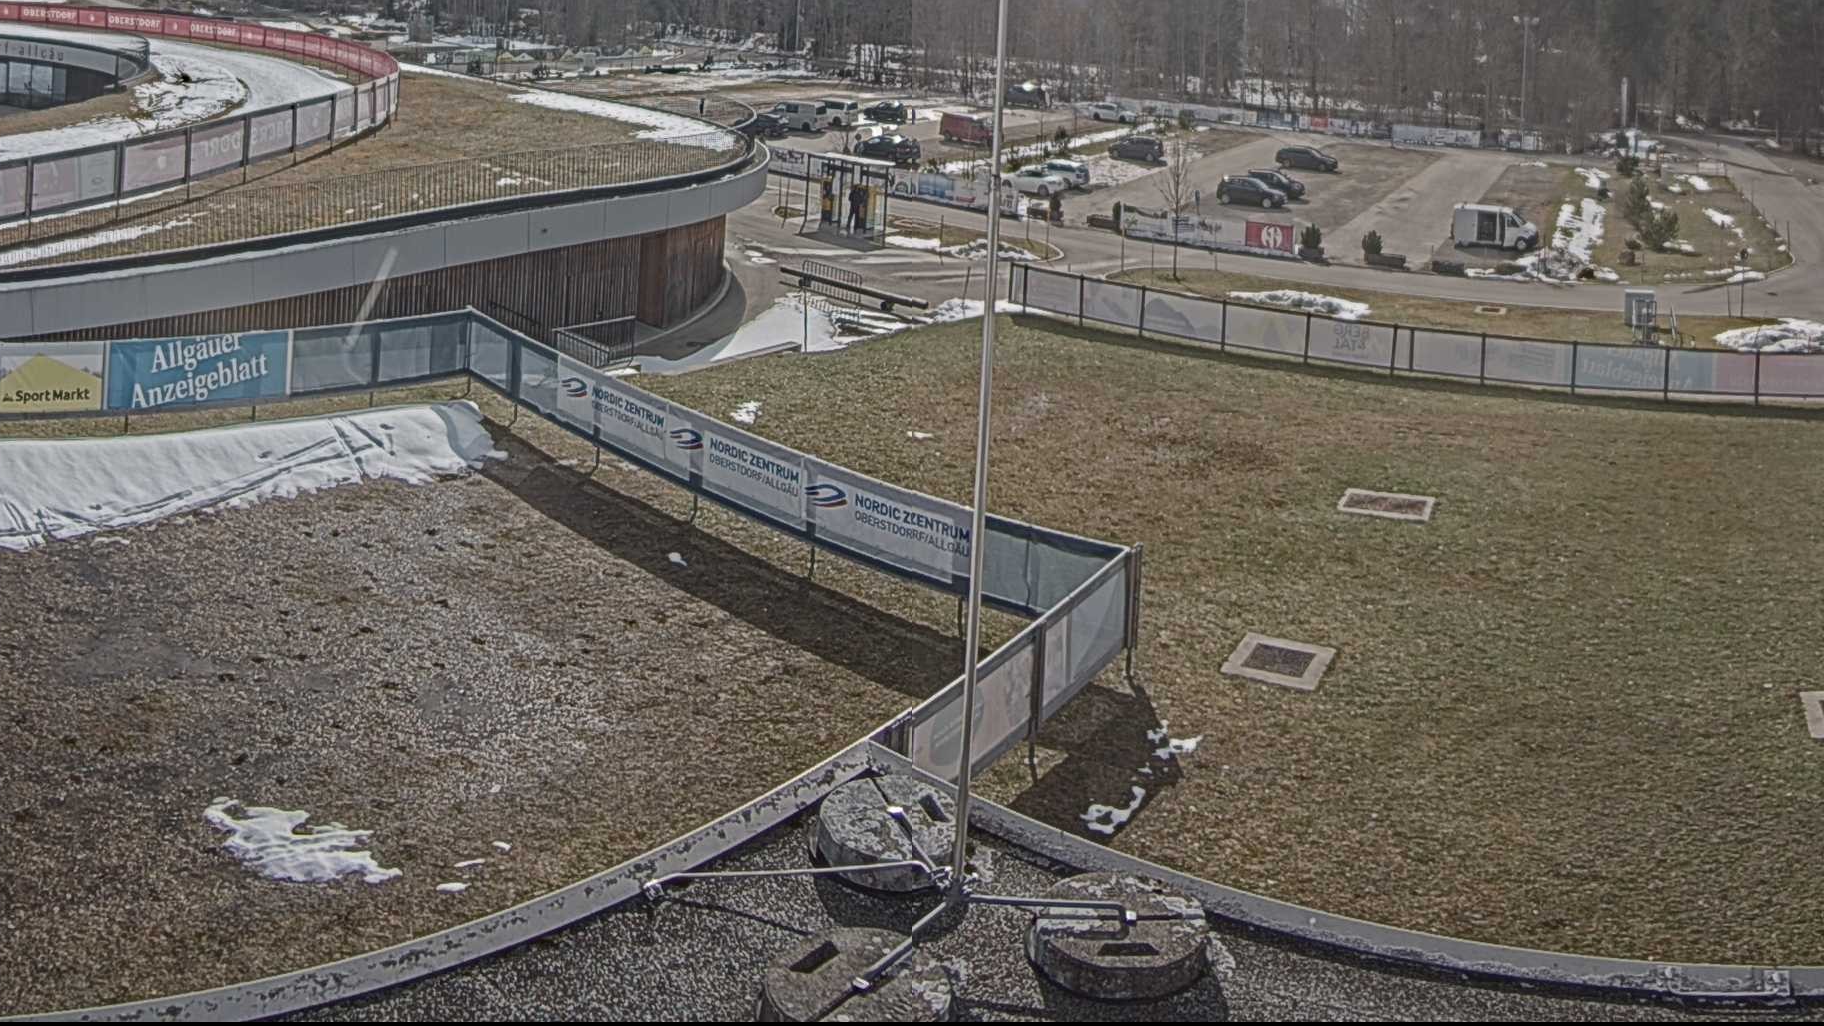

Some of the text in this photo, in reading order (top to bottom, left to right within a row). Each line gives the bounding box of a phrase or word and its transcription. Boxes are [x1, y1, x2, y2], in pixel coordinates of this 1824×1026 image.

[151, 333, 243, 373] Allgäuer
[131, 353, 269, 409] Anzeigeblatt
[592, 386, 665, 427] NORDIC ZENTRUM
[710, 437, 800, 484] NORDIC ZENTRUM
[855, 493, 901, 521] NORDIC
